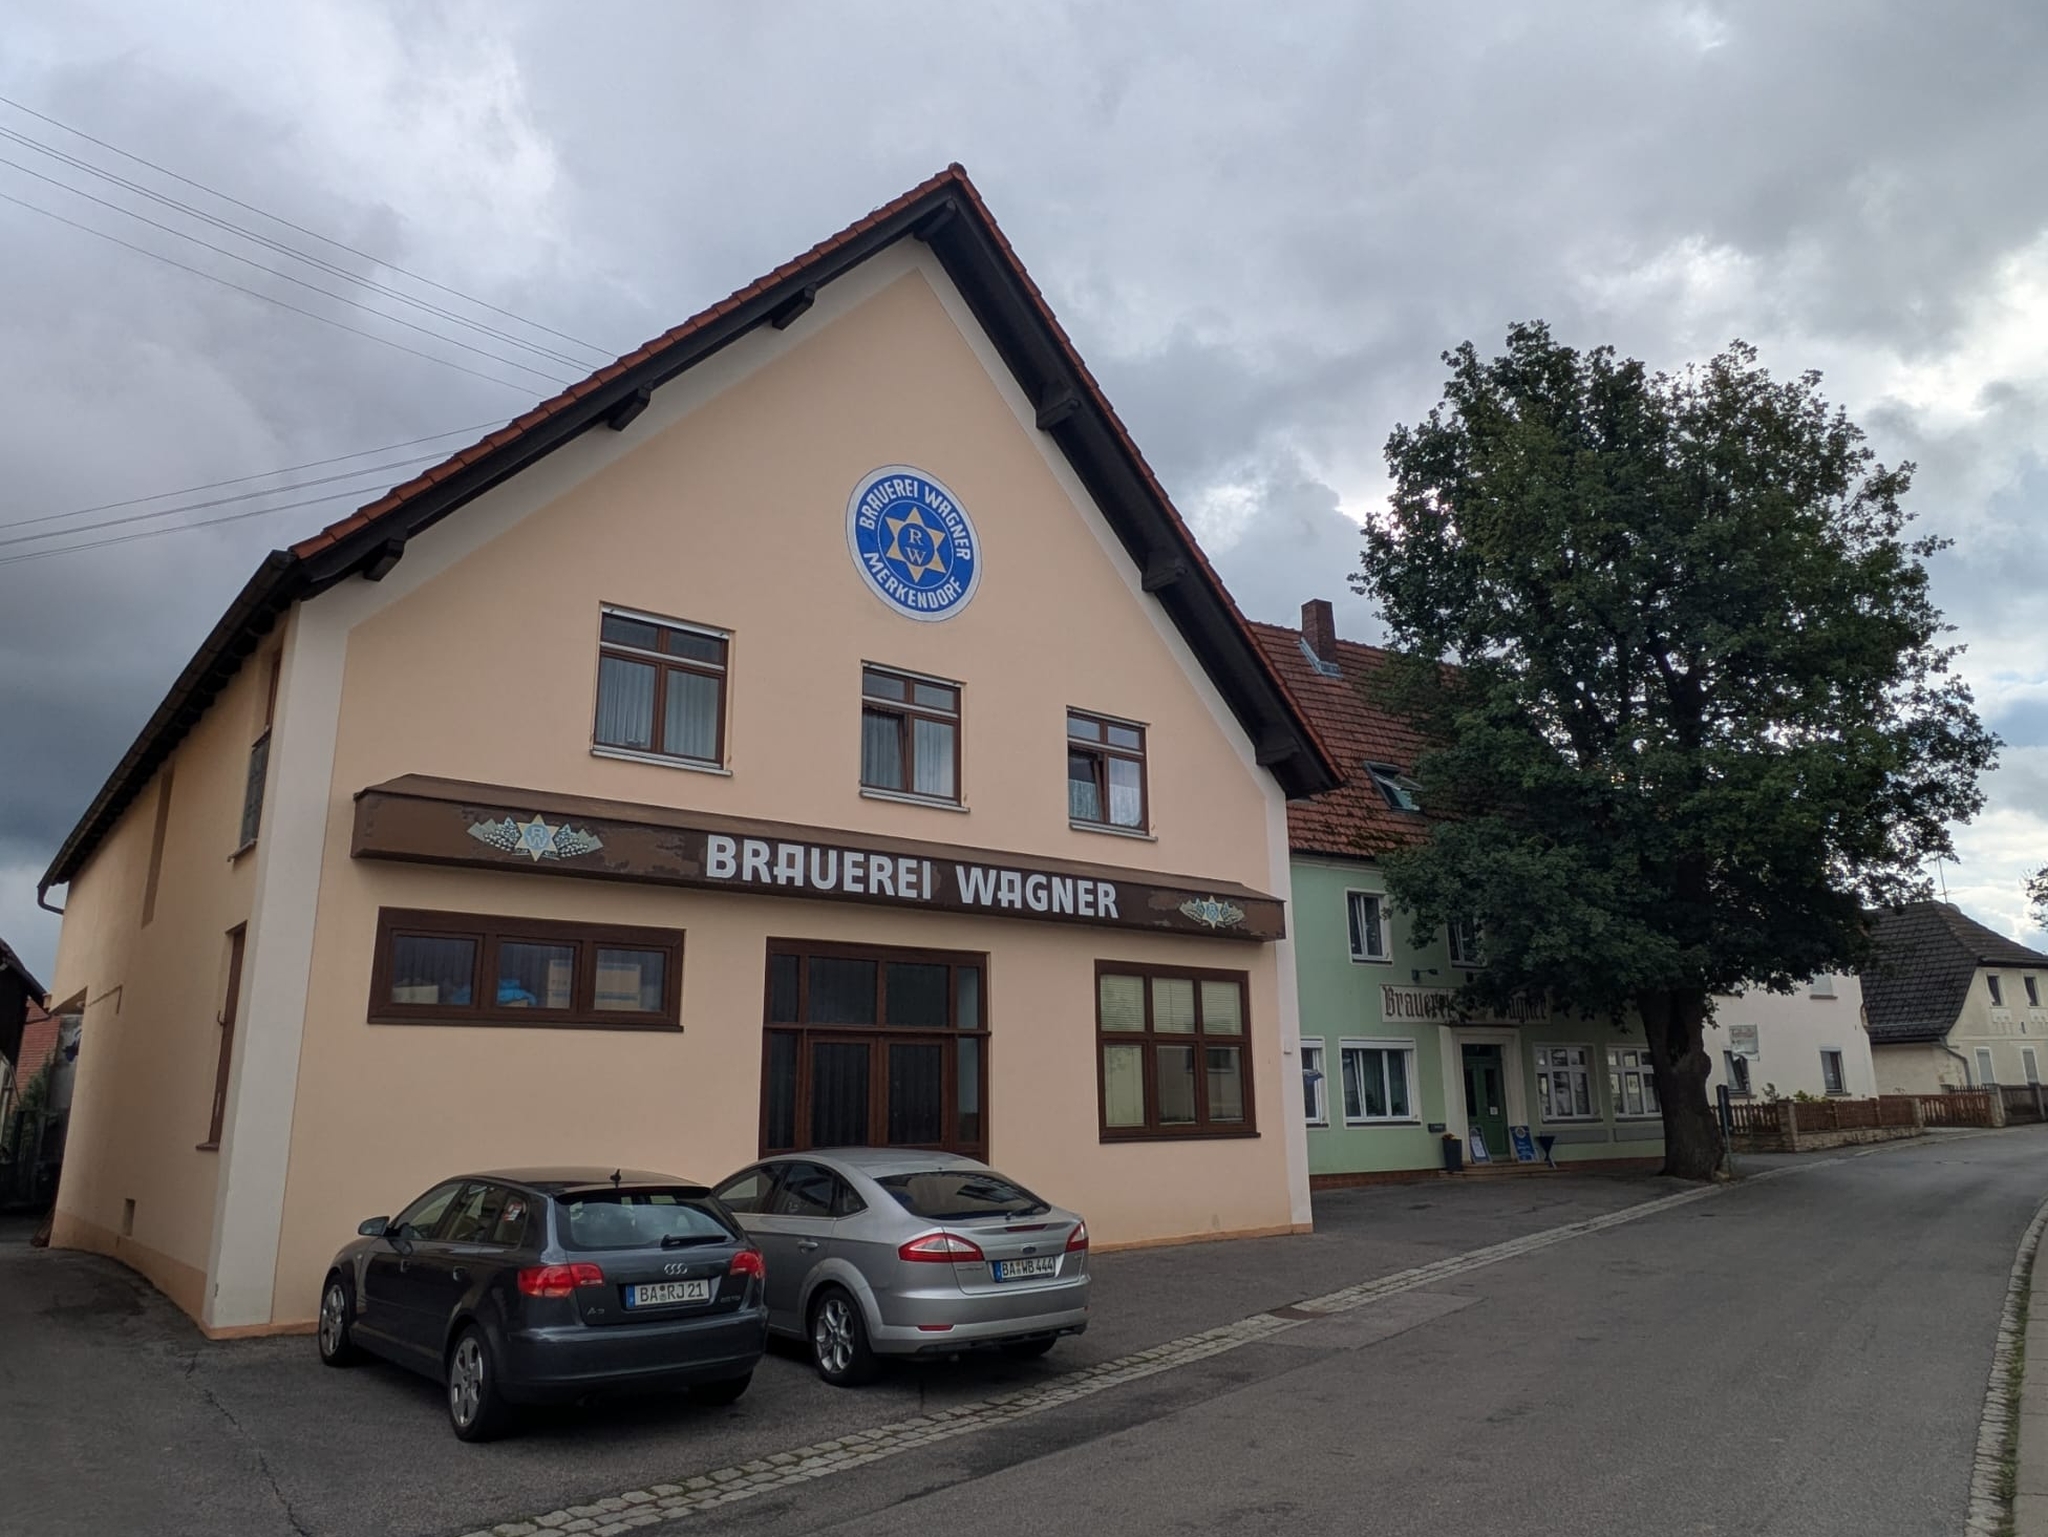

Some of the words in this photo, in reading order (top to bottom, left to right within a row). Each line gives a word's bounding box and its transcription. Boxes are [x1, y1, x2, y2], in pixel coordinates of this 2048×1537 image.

[859, 478, 918, 531] BRAUEREI
[924, 486, 971, 561] WAGNER
[908, 528, 923, 546] R
[905, 547, 926, 566] W
[863, 551, 963, 609] MERKENDORF
[706, 834, 932, 900] BRAUEREI
[955, 865, 1119, 919] WAGNER
[1002, 1262, 1016, 1277] BA
[1022, 1260, 1034, 1274] WB
[1036, 1258, 1053, 1272] 444
[640, 1285, 660, 1302] BA
[667, 1283, 685, 1300] RJ
[688, 1282, 704, 1298] 21
